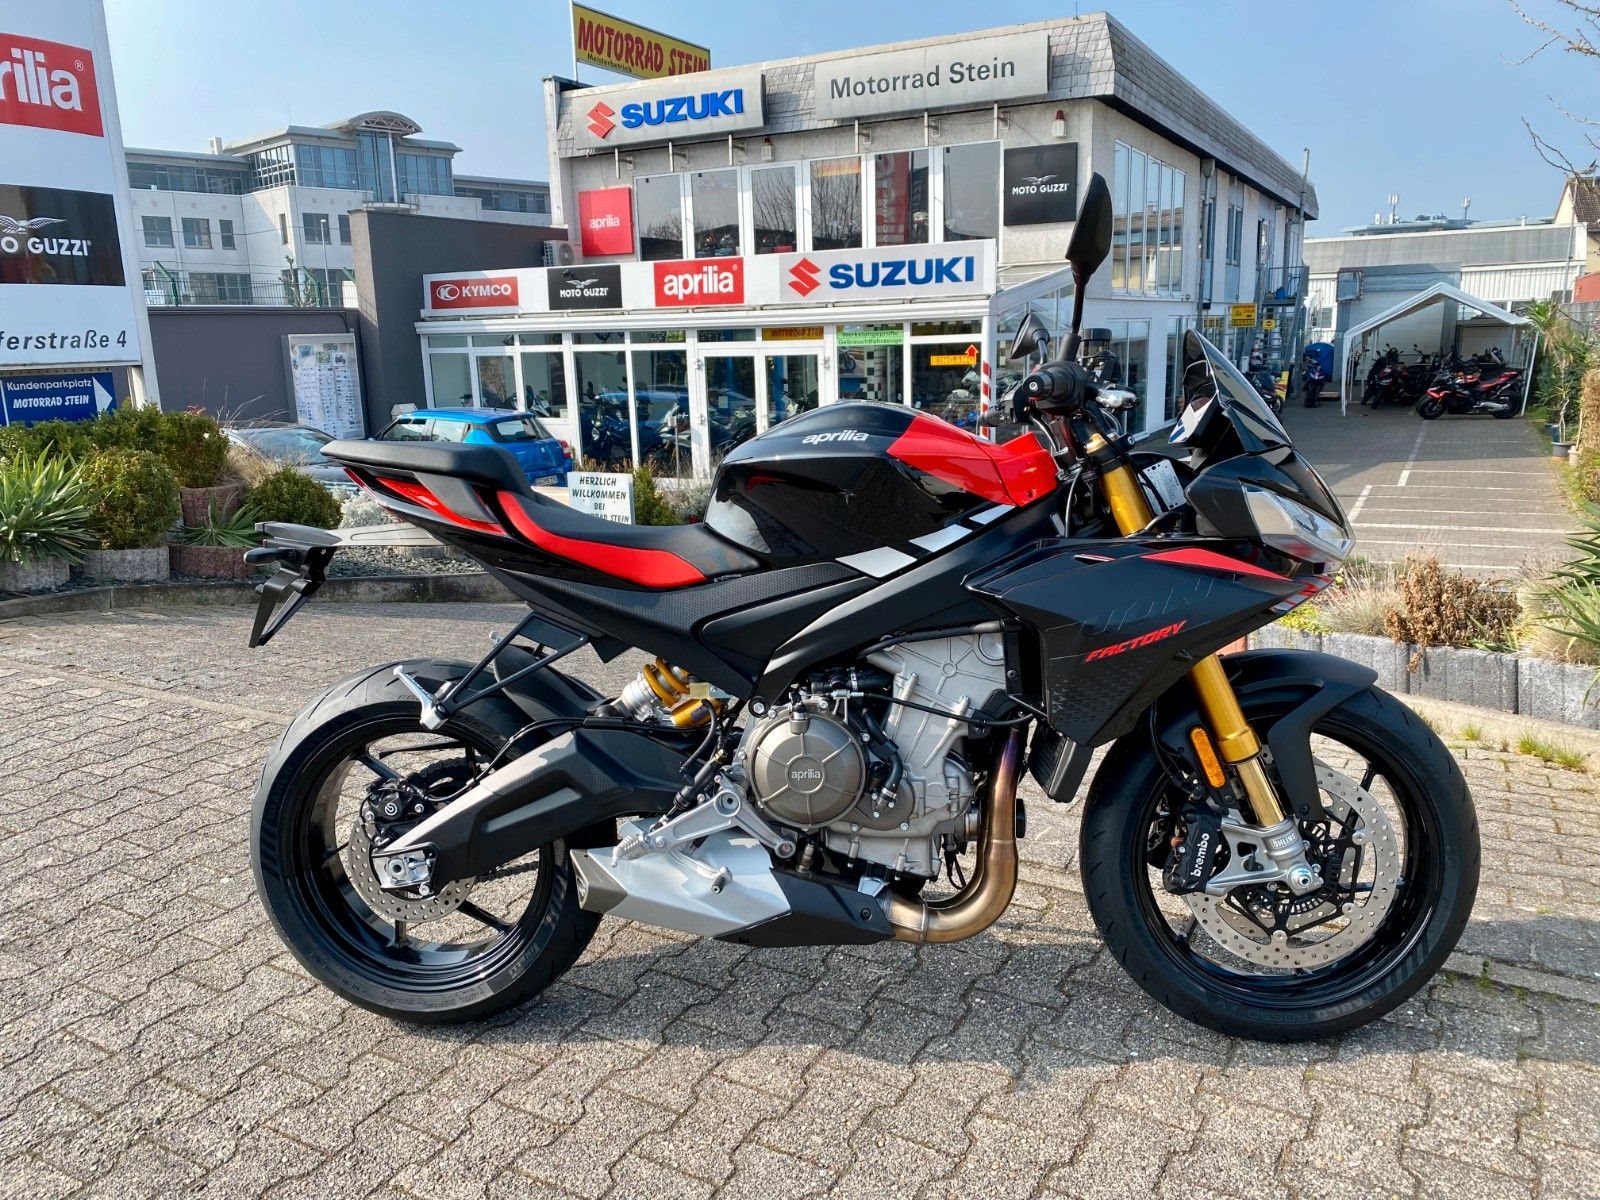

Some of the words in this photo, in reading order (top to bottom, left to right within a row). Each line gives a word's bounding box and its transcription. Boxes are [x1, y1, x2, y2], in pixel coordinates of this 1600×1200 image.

[577, 17, 664, 73] MOTORRAD
[587, 53, 633, 73] Meisterbetrieb
[831, 65, 940, 99] Motorrad
[949, 57, 1015, 84] Stein
[621, 88, 744, 129] SUZUKI
[1012, 185, 1037, 194] MOTO
[1040, 182, 1068, 193] GUZZI
[589, 213, 620, 230] aprilia
[27, 237, 89, 256] GUZZI
[663, 265, 735, 298] aprilia
[829, 256, 975, 290] SUZUKI
[462, 284, 512, 298] KYMCO
[559, 289, 582, 298] MOTO
[583, 287, 607, 297] GUZZI
[117, 330, 127, 348] 4
[7, 379, 92, 391] Kundenparkplatz
[13, 397, 63, 409] MOTORRAD
[65, 394, 89, 406] STEIN
[802, 429, 869, 445] aprilia
[580, 476, 617, 487] HERZLICH
[572, 489, 627, 500] WILLKOMMEN
[610, 514, 629, 522] STEIN
[1085, 620, 1187, 662] FACTORY
[791, 768, 821, 780] aprilia
[1190, 832, 1210, 877] brembo
